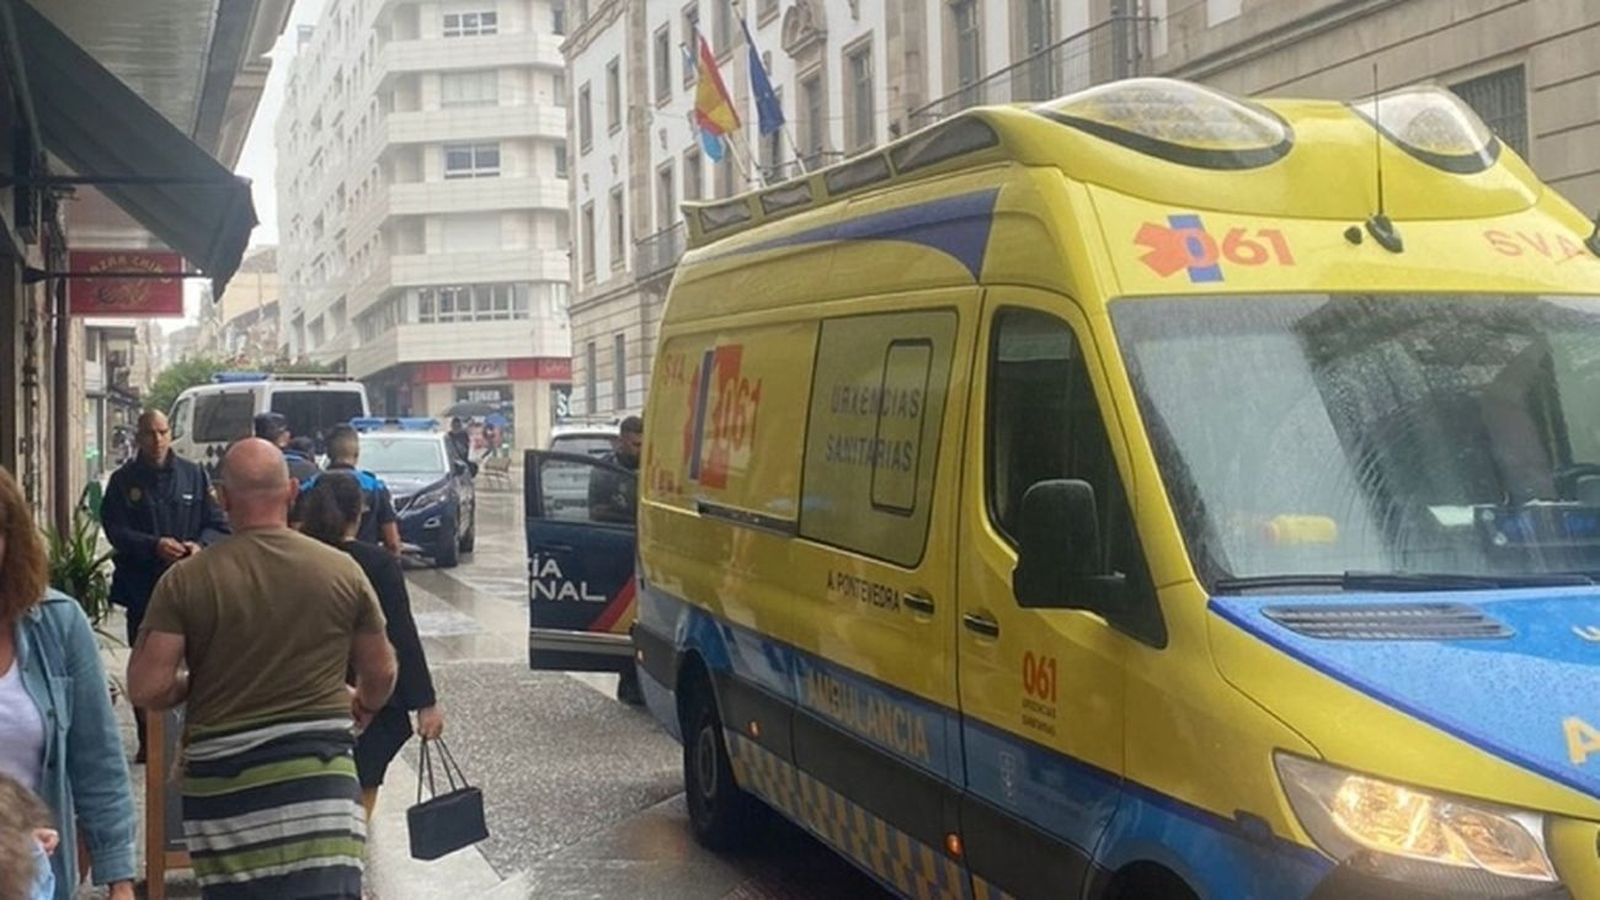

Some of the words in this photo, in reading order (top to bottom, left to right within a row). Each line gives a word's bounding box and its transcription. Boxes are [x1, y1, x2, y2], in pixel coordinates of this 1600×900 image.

[528, 552, 562, 578] ÍA
[531, 580, 607, 601] NAL
[1023, 650, 1057, 703] 061
[804, 667, 930, 764] AMBULANCIA
